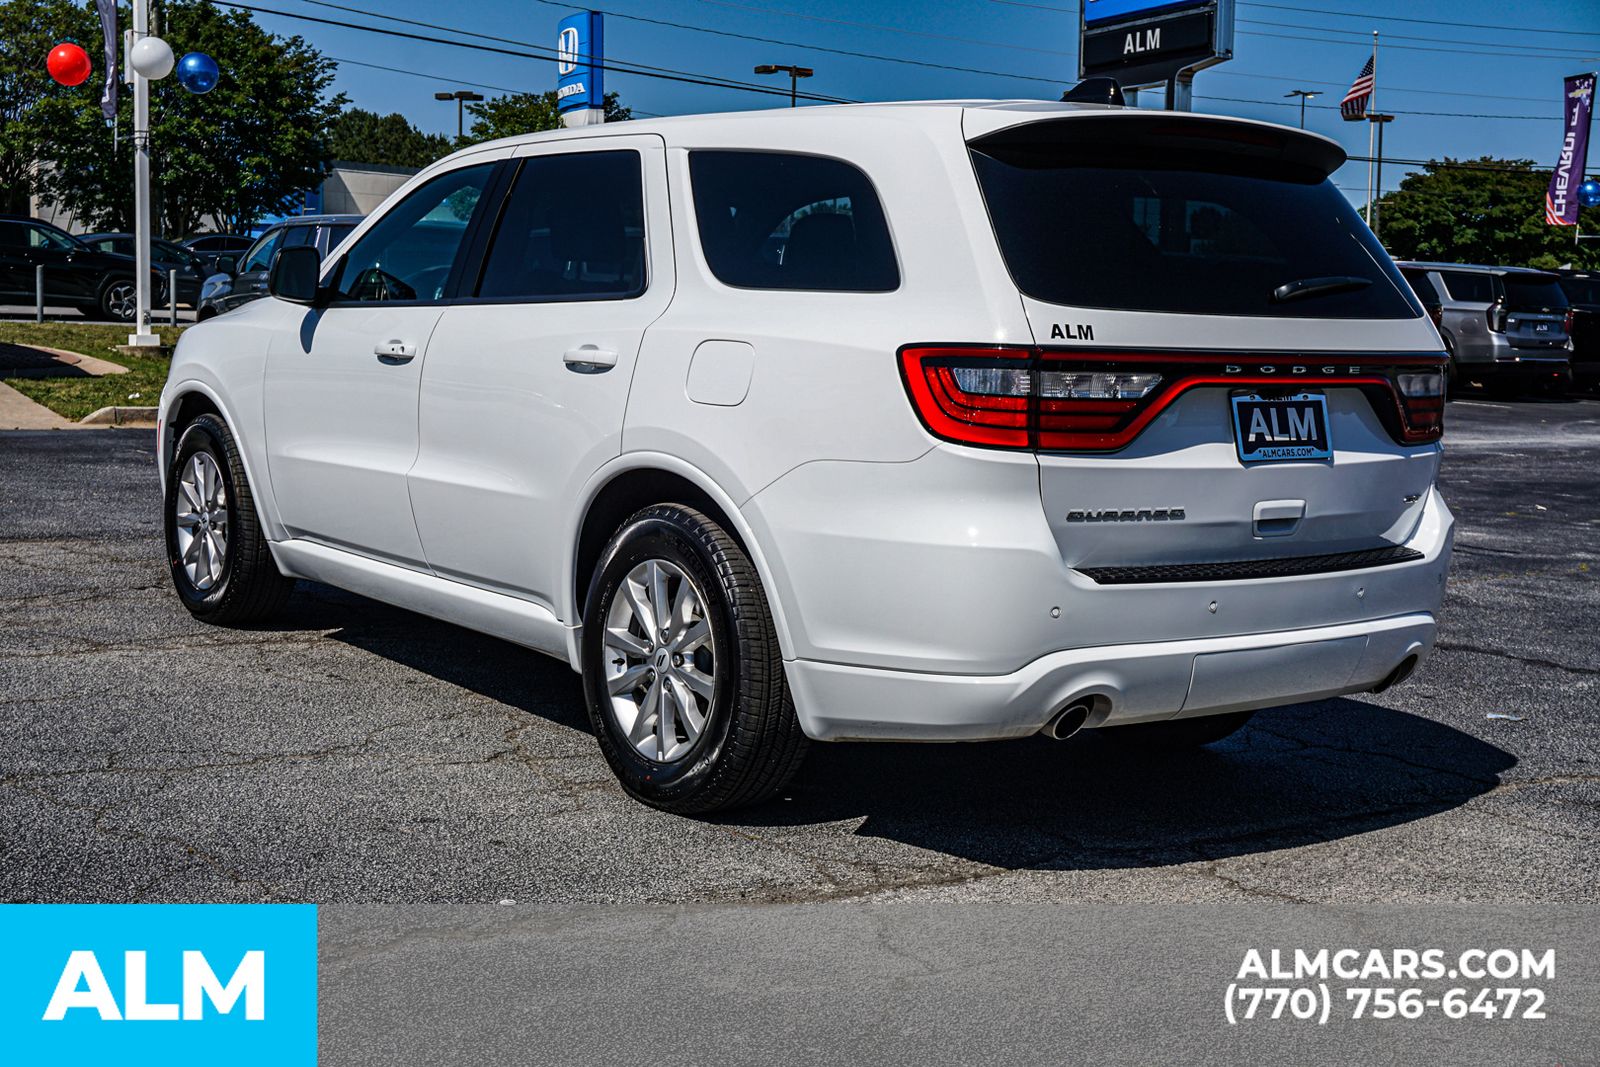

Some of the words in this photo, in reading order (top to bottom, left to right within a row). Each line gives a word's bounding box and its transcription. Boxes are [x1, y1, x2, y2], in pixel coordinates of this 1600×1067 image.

[1123, 28, 1161, 54] ALM
[1051, 323, 1094, 341] ALM
[1225, 364, 1361, 375] DODGE
[1248, 407, 1318, 442] ALM
[1262, 448, 1313, 459] ALMCARS.COM
[1066, 506, 1186, 522] DURANGO
